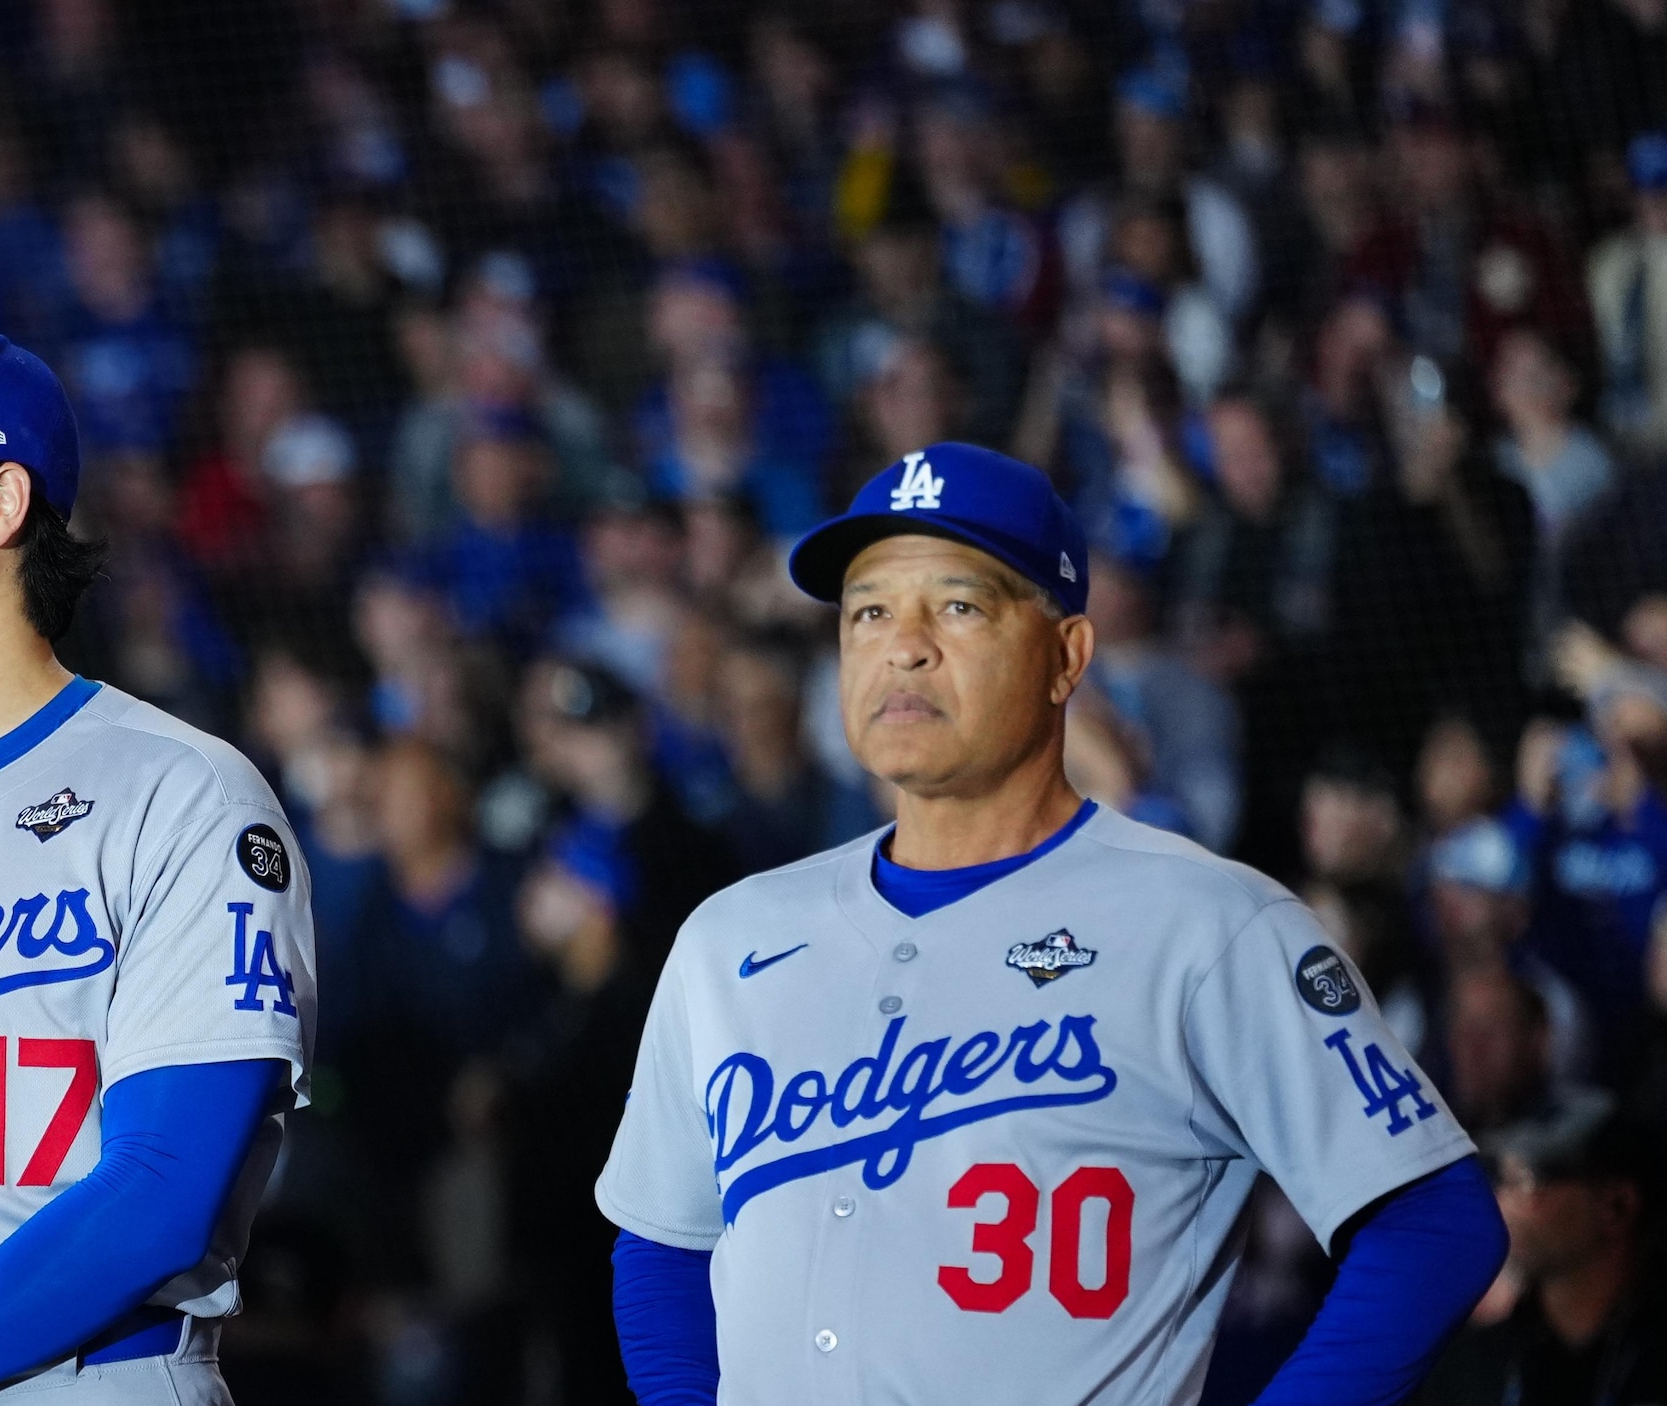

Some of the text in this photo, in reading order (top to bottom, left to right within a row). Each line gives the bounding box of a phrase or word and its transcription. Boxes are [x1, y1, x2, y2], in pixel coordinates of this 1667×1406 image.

[890, 451, 945, 511] LA
[250, 846, 283, 883] 34
[224, 902, 296, 1017] LA
[706, 1015, 1116, 1190] Dodgers
[1323, 1028, 1438, 1137] LA
[937, 1162, 1135, 1320] 30
